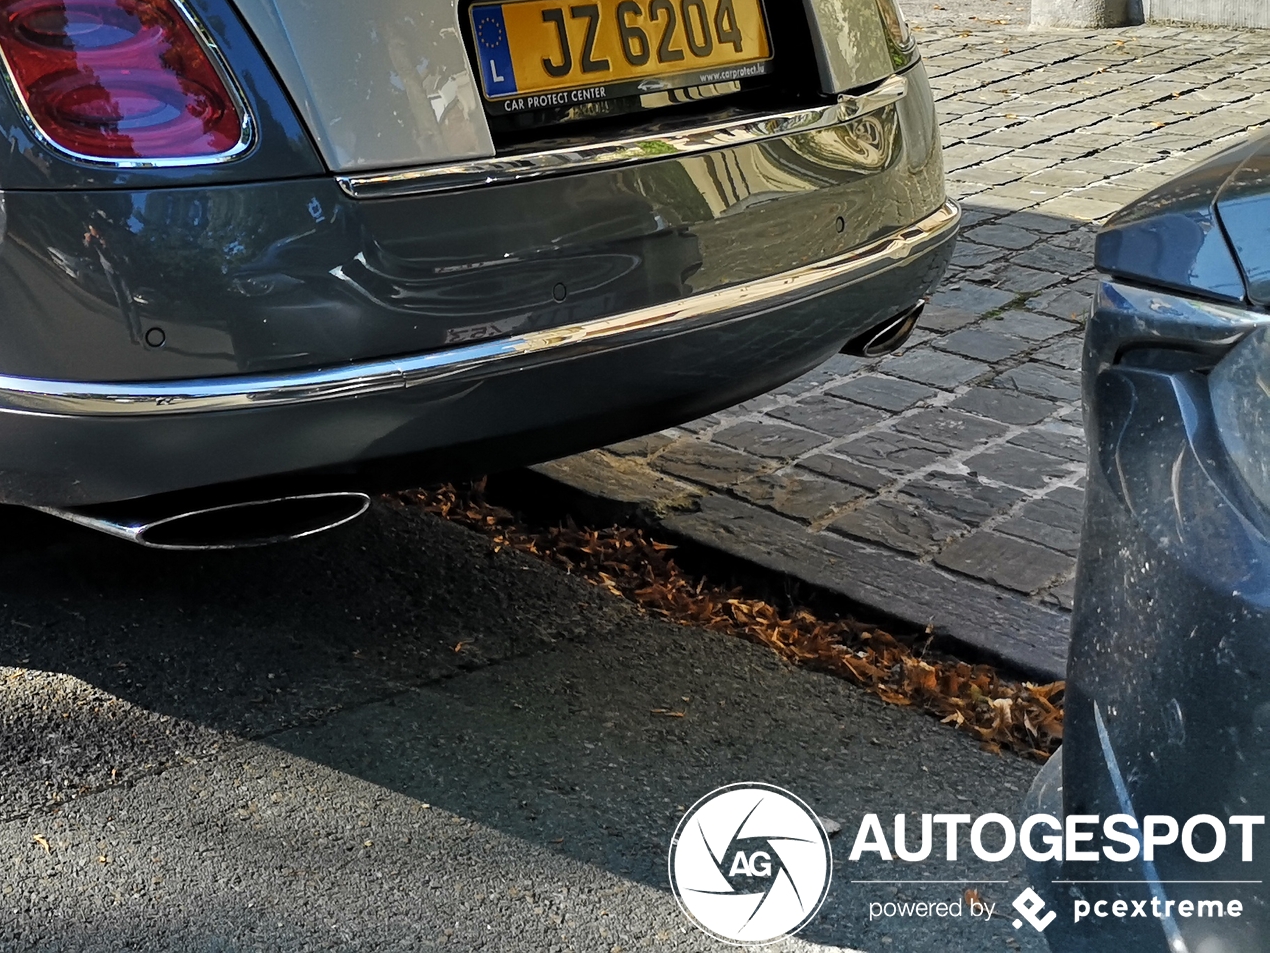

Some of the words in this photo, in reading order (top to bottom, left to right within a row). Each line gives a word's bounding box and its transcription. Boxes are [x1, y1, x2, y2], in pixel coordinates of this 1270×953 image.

[542, 3, 611, 78] JZ
[489, 59, 504, 83] L
[699, 62, 766, 82] www.carprotect.lu
[504, 98, 525, 112] CAR
[527, 92, 569, 109] PROTECT
[571, 86, 607, 102] CENTER
